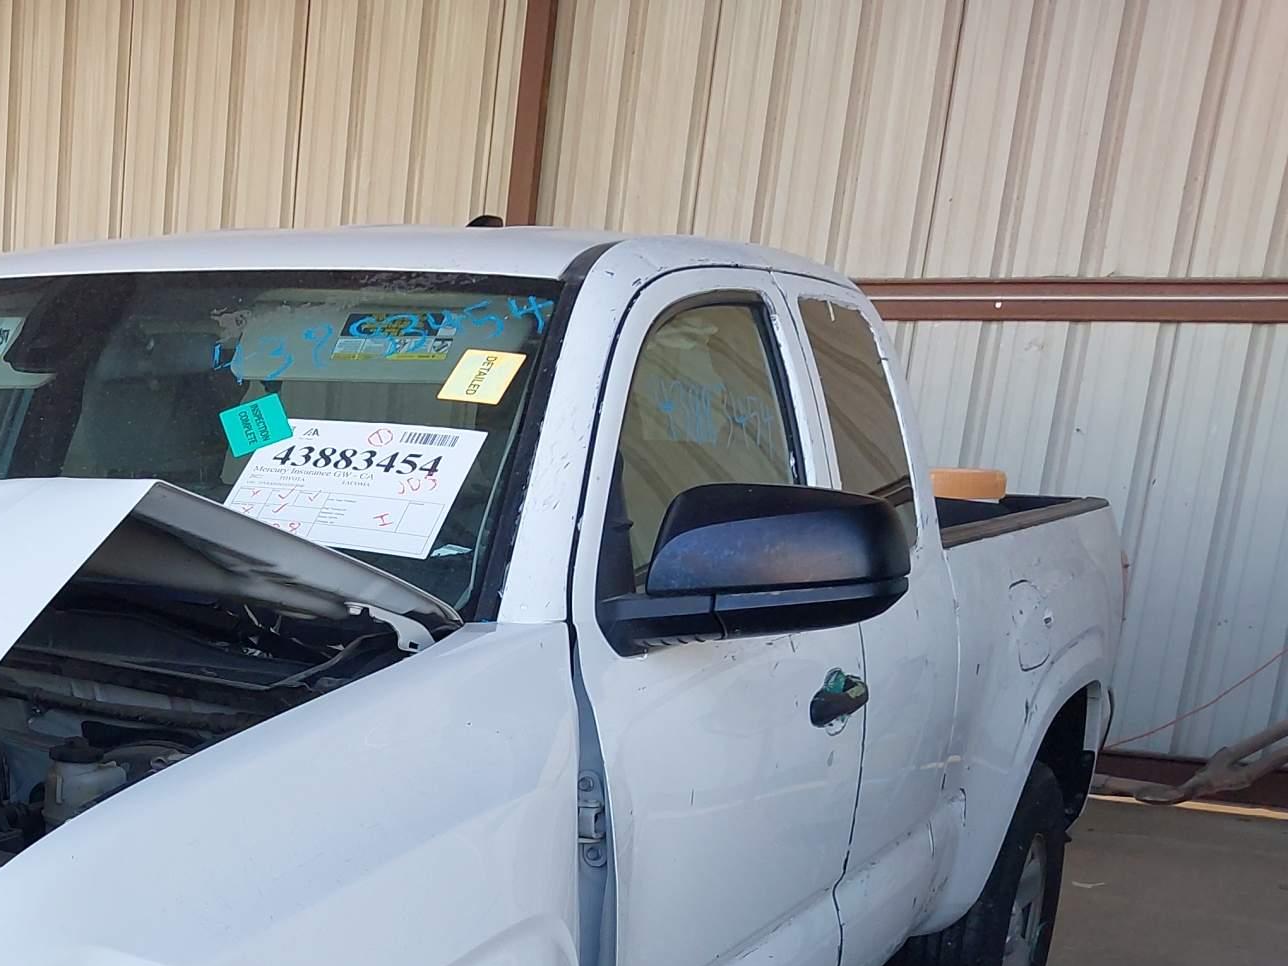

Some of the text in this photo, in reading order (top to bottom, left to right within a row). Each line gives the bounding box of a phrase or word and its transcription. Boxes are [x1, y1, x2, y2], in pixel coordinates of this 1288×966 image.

[465, 355, 498, 395] DETAILED
[238, 410, 258, 446] COMPLETE
[251, 403, 271, 442] INSPECTION
[253, 465, 289, 475] Mercury
[290, 467, 331, 477] Insurance
[273, 445, 443, 477] 43883454
